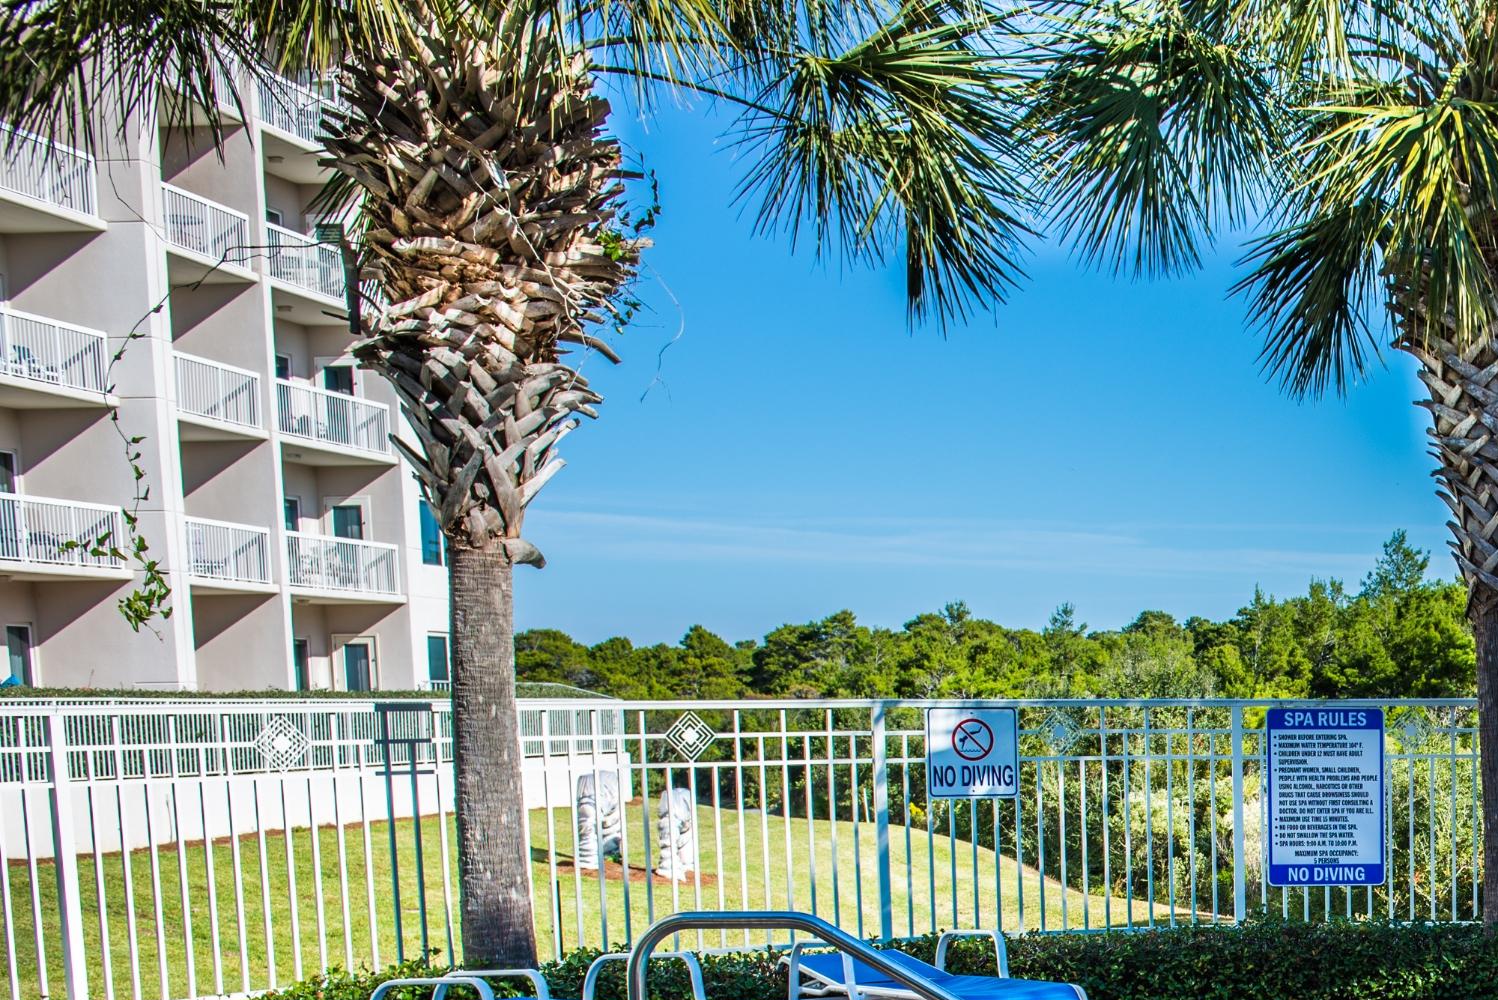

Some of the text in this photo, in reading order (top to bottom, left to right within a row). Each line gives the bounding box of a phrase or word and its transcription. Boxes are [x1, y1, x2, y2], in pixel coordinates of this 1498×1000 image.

[1284, 712, 1367, 726] SPA RULES
[934, 766, 1013, 787] NO DIVING
[1288, 867, 1365, 881] NO DIVING
